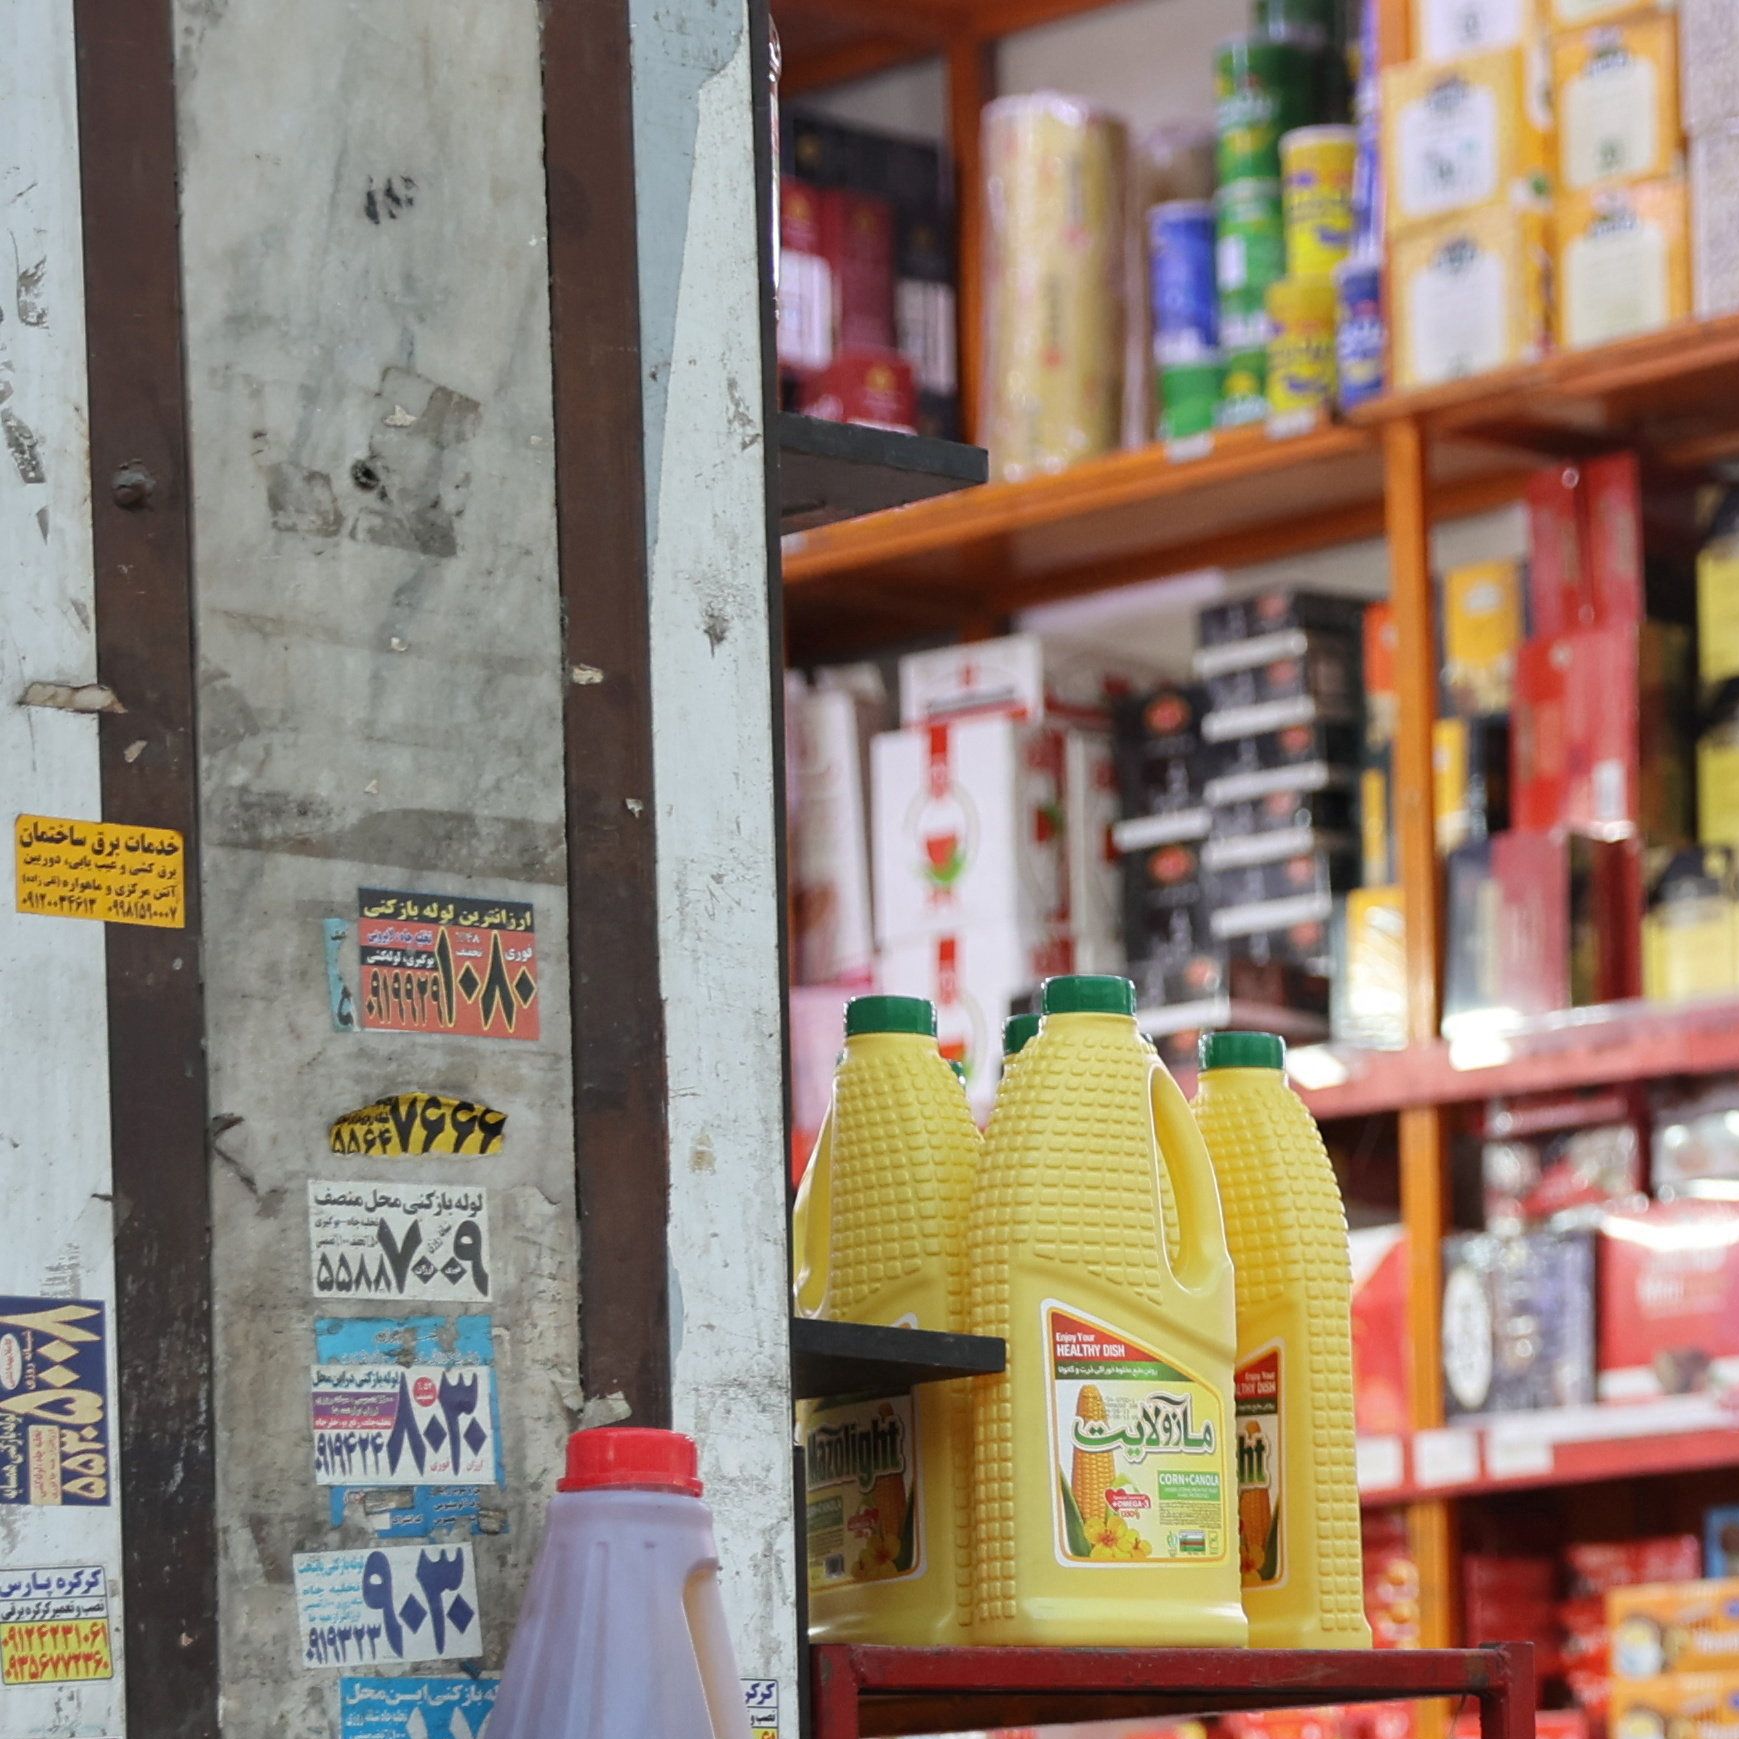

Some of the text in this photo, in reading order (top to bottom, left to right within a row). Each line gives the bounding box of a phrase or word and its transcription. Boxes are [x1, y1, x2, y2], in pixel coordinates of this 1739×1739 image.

[19, 821, 179, 857] خدمات برق ساختمان
[504, 944, 533, 962] فوری
[314, 1187, 363, 1207] منصف
[364, 1189, 401, 1212] محل
[454, 1192, 483, 1217] لوله
[1055, 1332, 1095, 1343] Enjoy Your
[1056, 1343, 1125, 1357] HEALTHY DISH
[1074, 1393, 1213, 1457] مازولایت
[1159, 1472, 1220, 1487] CORN+CANOLA
[0, 1569, 102, 1598] کرکره پارس
